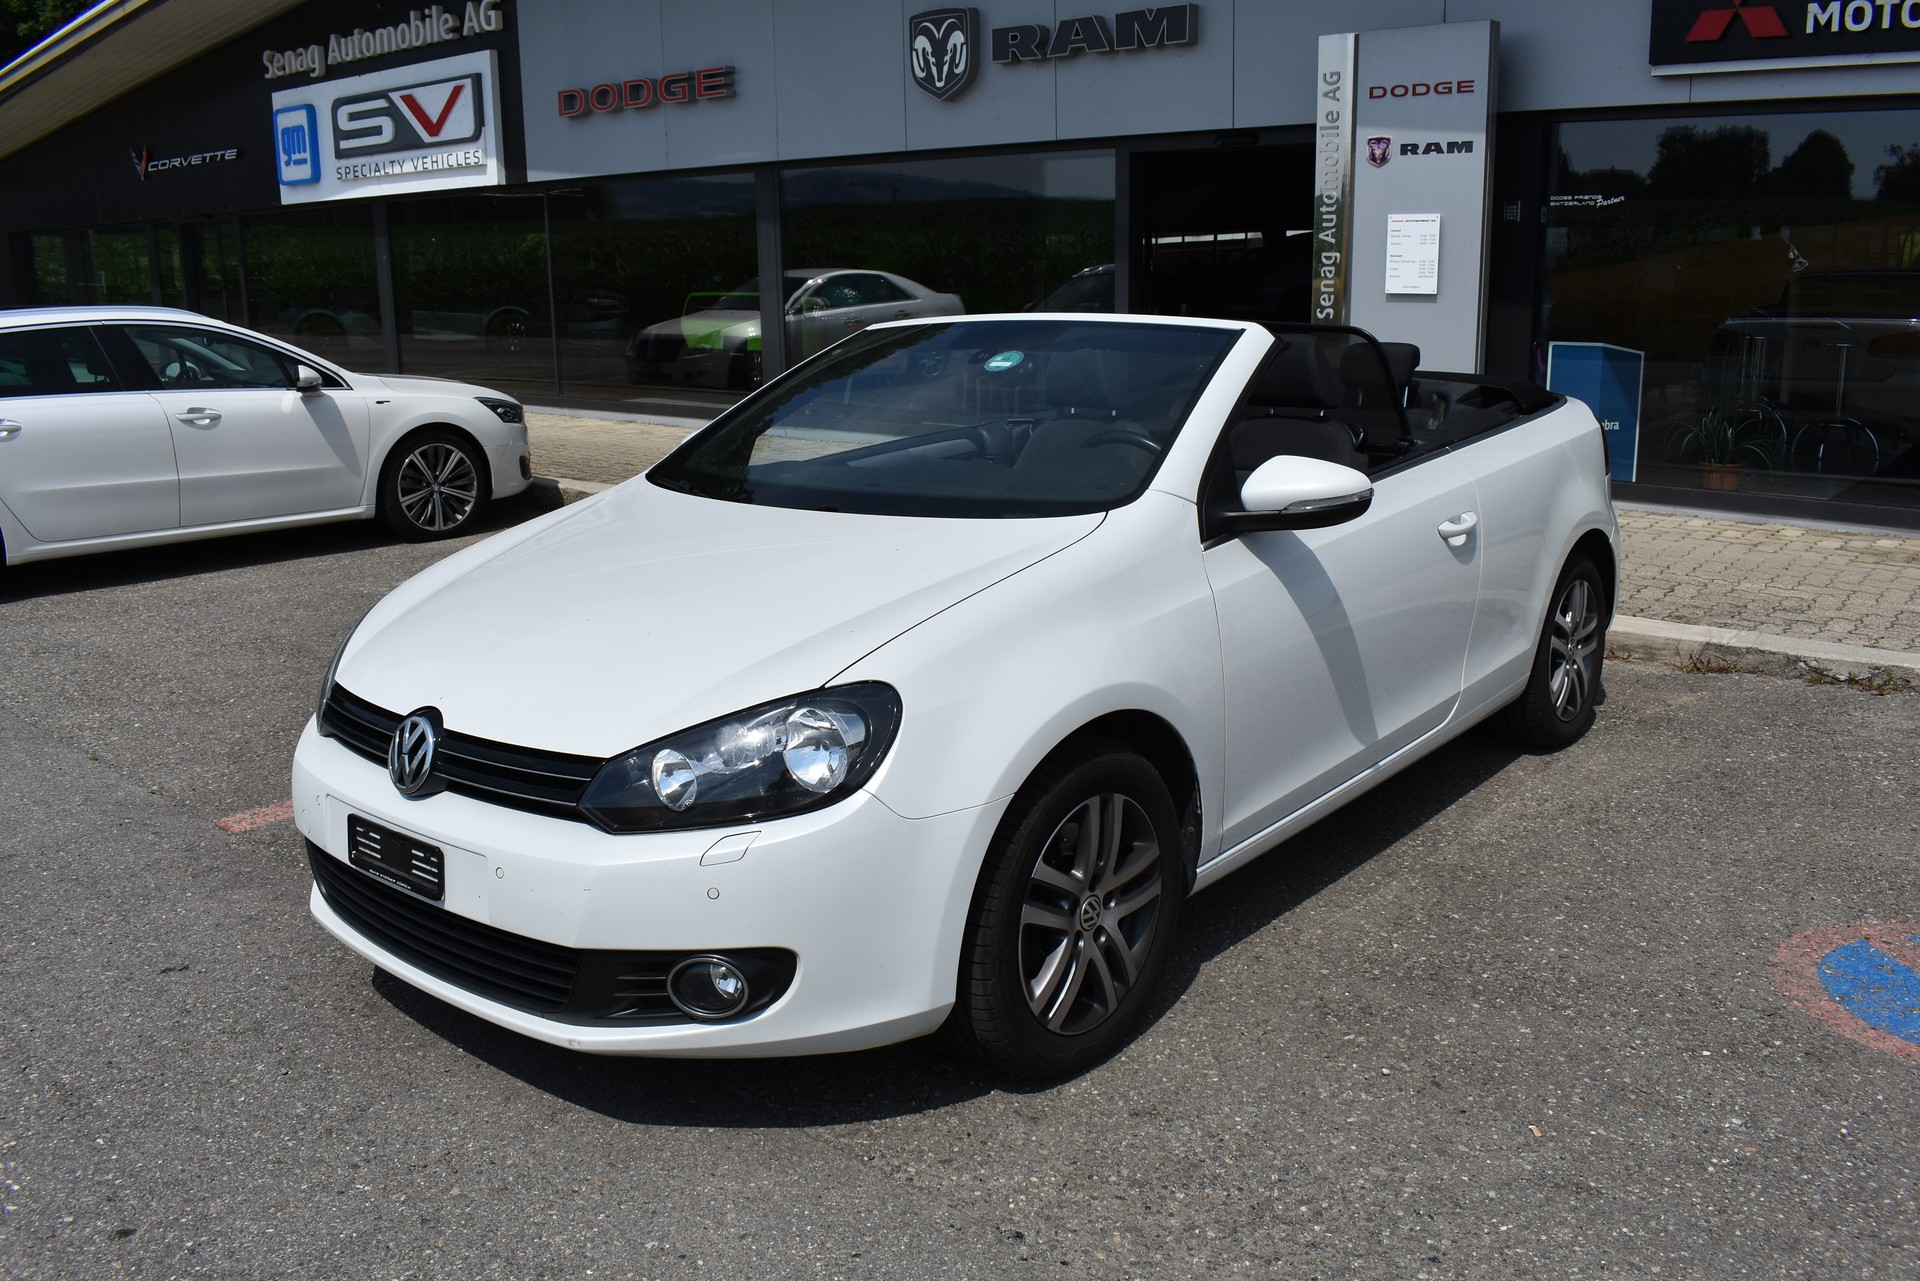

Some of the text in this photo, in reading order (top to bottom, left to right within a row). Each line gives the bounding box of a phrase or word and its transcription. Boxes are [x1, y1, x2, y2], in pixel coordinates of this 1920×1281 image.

[263, 0, 503, 79] Senag Automobile AG
[992, 2, 1196, 63] RAM
[558, 66, 732, 118] DODGE
[1369, 80, 1475, 99] DODGE
[337, 84, 465, 150] SV
[148, 149, 237, 171] CORVETTE
[337, 150, 481, 180] SPECIALTY VEHICLES
[1400, 141, 1474, 156] RAM
[1316, 70, 1341, 320] Senag Automobile AG
[1596, 196, 1625, 208] Partner
